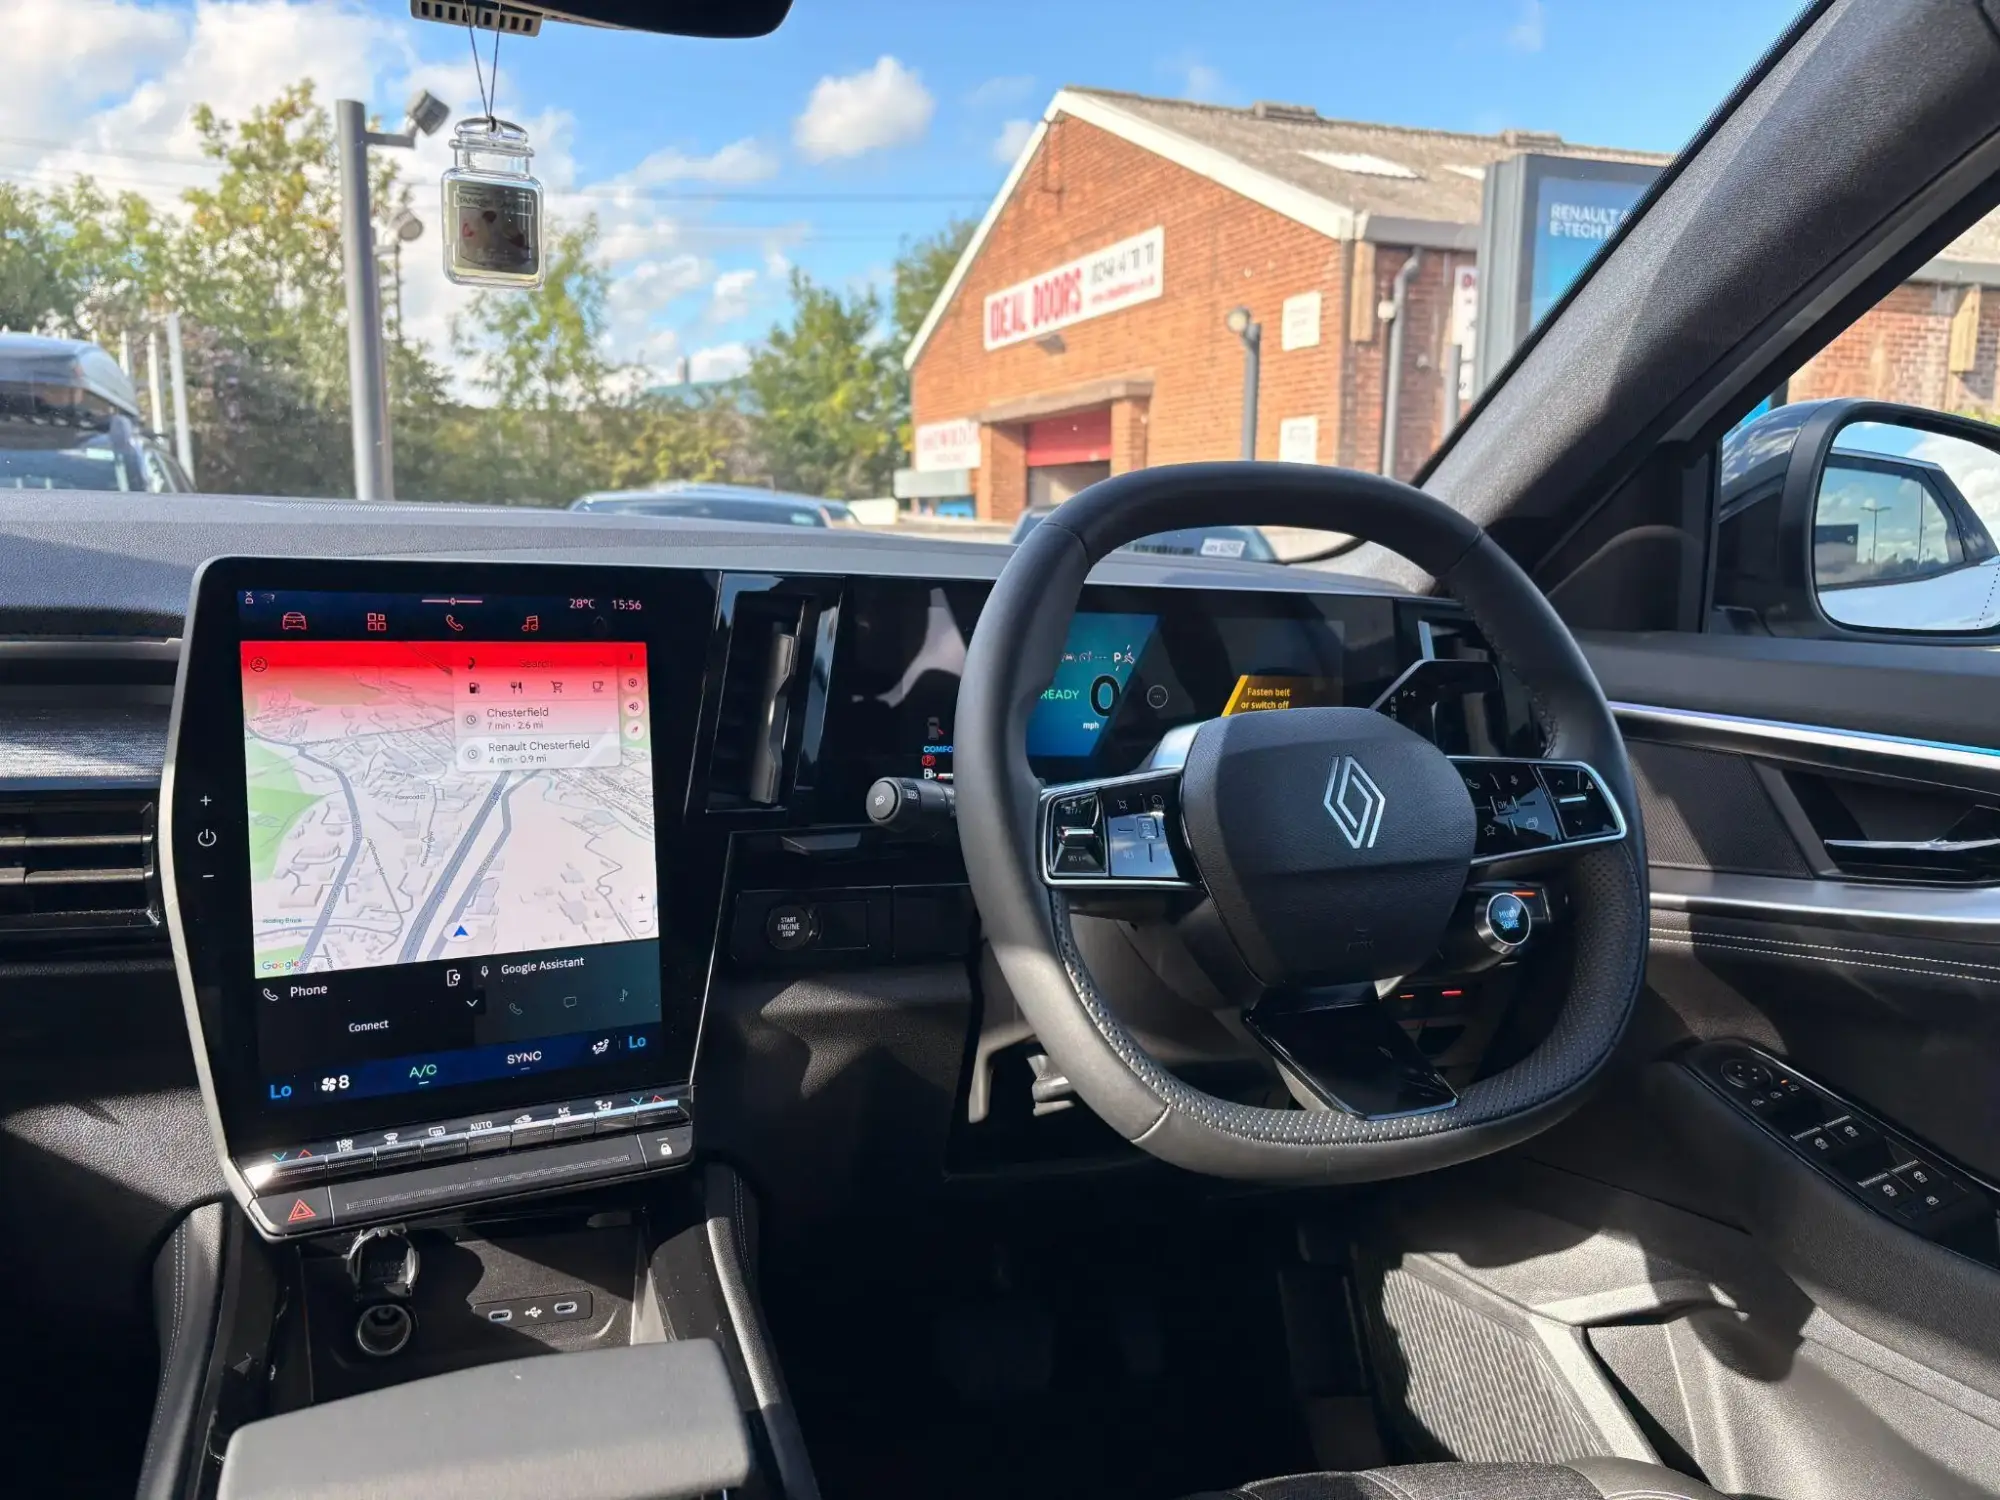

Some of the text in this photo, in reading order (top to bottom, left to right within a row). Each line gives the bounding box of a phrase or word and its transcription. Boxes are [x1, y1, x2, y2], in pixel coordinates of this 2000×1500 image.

[1550, 203, 1619, 224] RENAULT
[1032, 267, 1081, 328] DOORS
[611, 599, 642, 611] 15:56
[1113, 652, 1121, 663] P
[1040, 689, 1079, 700] READY
[1090, 673, 1121, 718] 0
[1247, 687, 1290, 696] Fasten belt
[1278, 701, 1289, 709] off
[486, 706, 549, 718] Chesterfield
[499, 721, 511, 730] min
[517, 721, 531, 730] 2.6
[535, 720, 543, 730] mi
[1082, 721, 1100, 730] mph
[488, 739, 590, 752] Renault Chesterfield
[498, 755, 513, 764] min
[520, 755, 534, 764] 0.9
[537, 754, 547, 763] mi
[780, 916, 797, 924] START
[777, 922, 800, 932] ENGINE
[782, 930, 796, 938] STOP
[262, 959, 300, 970] Google
[501, 956, 585, 976] Google Assistant
[290, 983, 328, 997] Phone
[348, 1020, 389, 1033] Connect
[628, 1035, 647, 1049] Lo
[507, 1050, 542, 1066] SYNC
[409, 1064, 438, 1079] A/C
[338, 1075, 350, 1089] 8
[270, 1084, 292, 1099] Lo
[470, 1121, 493, 1131] AUTO
